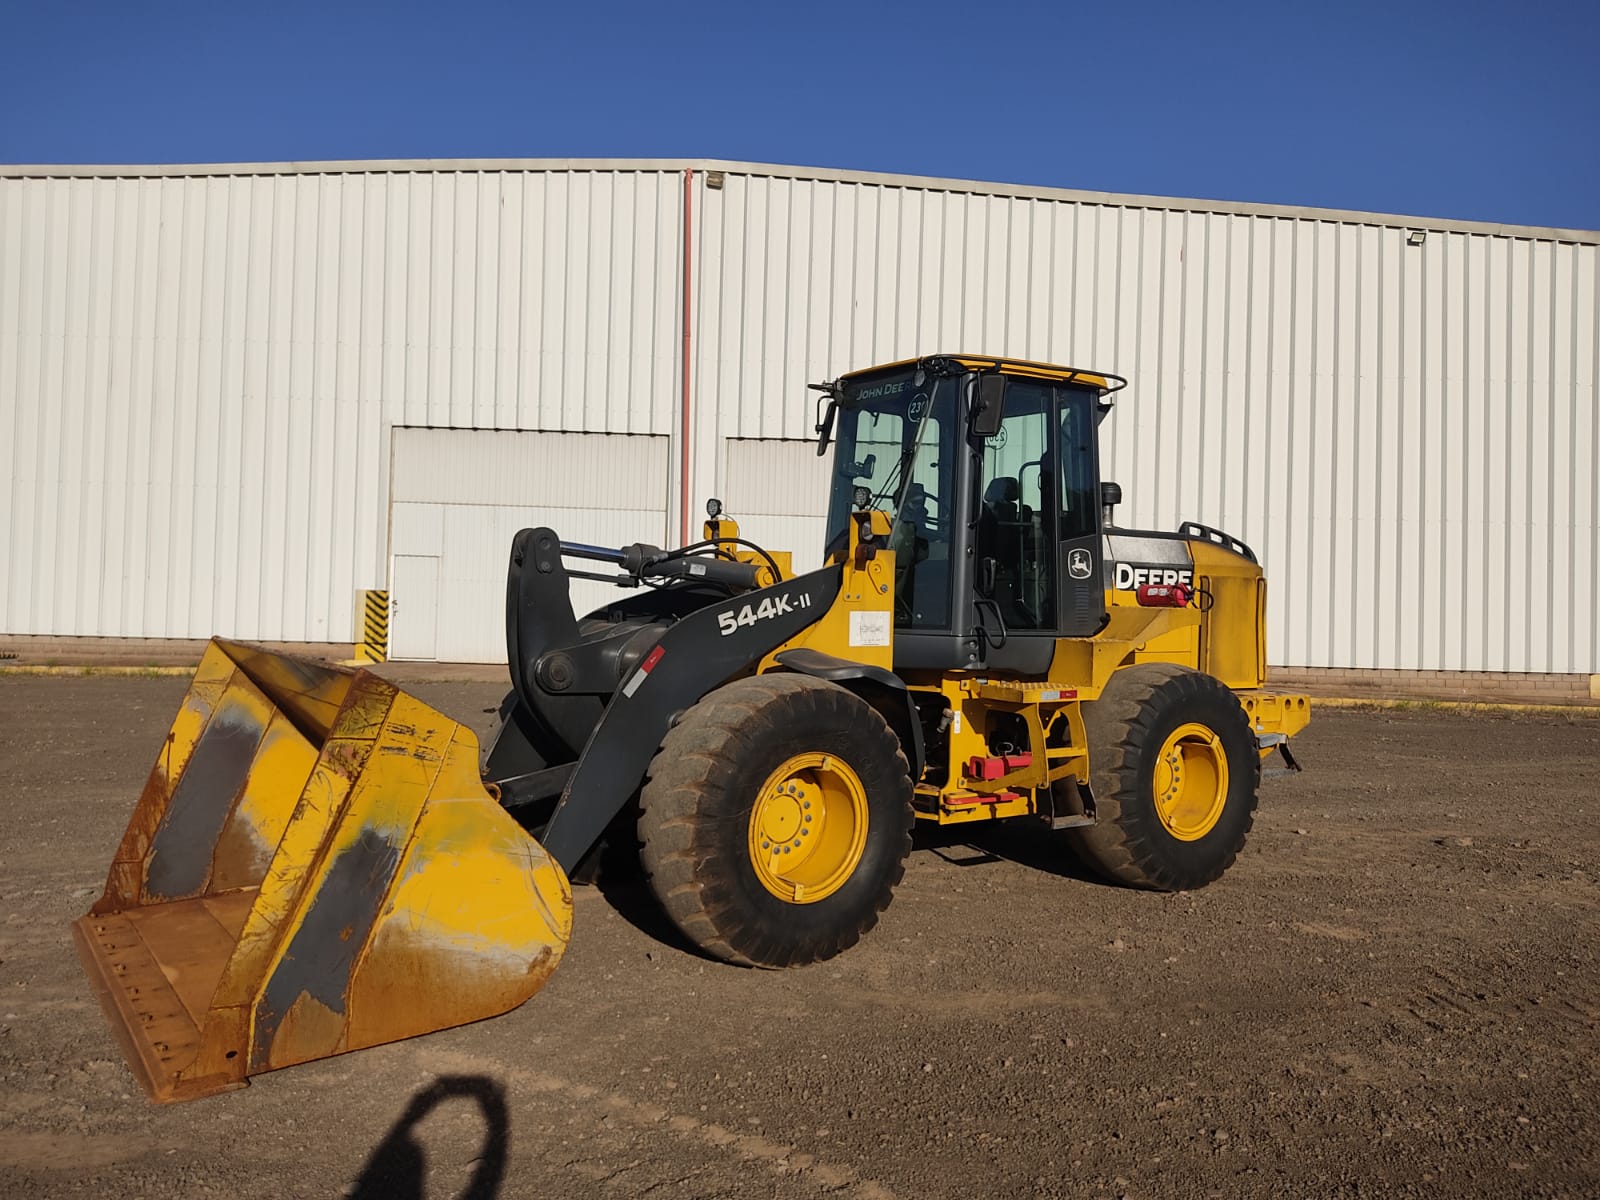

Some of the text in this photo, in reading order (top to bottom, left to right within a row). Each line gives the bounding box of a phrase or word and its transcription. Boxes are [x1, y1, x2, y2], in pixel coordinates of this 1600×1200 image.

[856, 388, 882, 400] JOHN
[1115, 563, 1192, 590] DEERE
[717, 593, 811, 636] 544K-II
